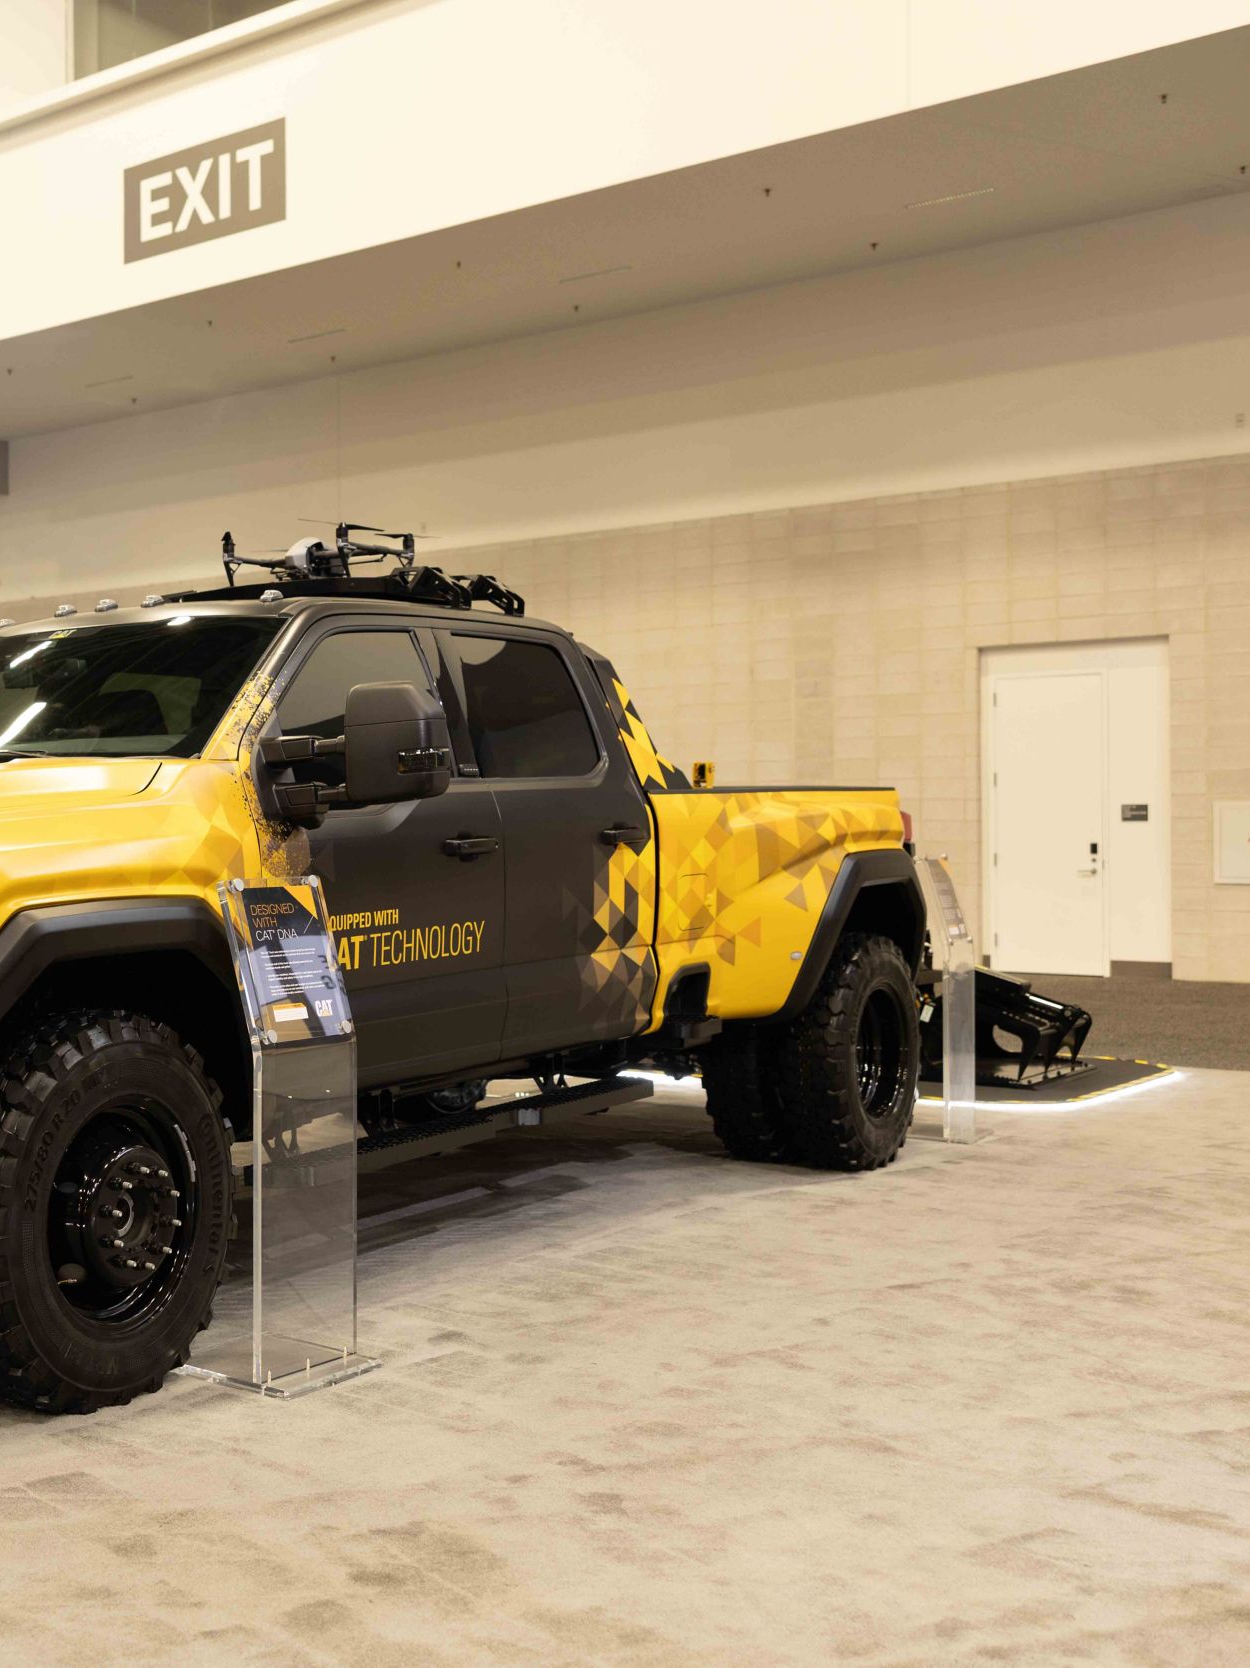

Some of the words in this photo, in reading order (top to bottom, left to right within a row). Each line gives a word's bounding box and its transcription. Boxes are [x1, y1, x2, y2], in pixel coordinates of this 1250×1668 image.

[140, 138, 274, 243] EXIT
[250, 903, 295, 916] DESIGNED
[252, 916, 278, 928] WITH
[329, 912, 372, 932] QUIPPED
[373, 909, 399, 927] WITH
[276, 928, 299, 940] DNA
[337, 935, 364, 971] AT
[370, 920, 485, 967] TECHNOLOGY
[314, 999, 333, 1017] CAT
